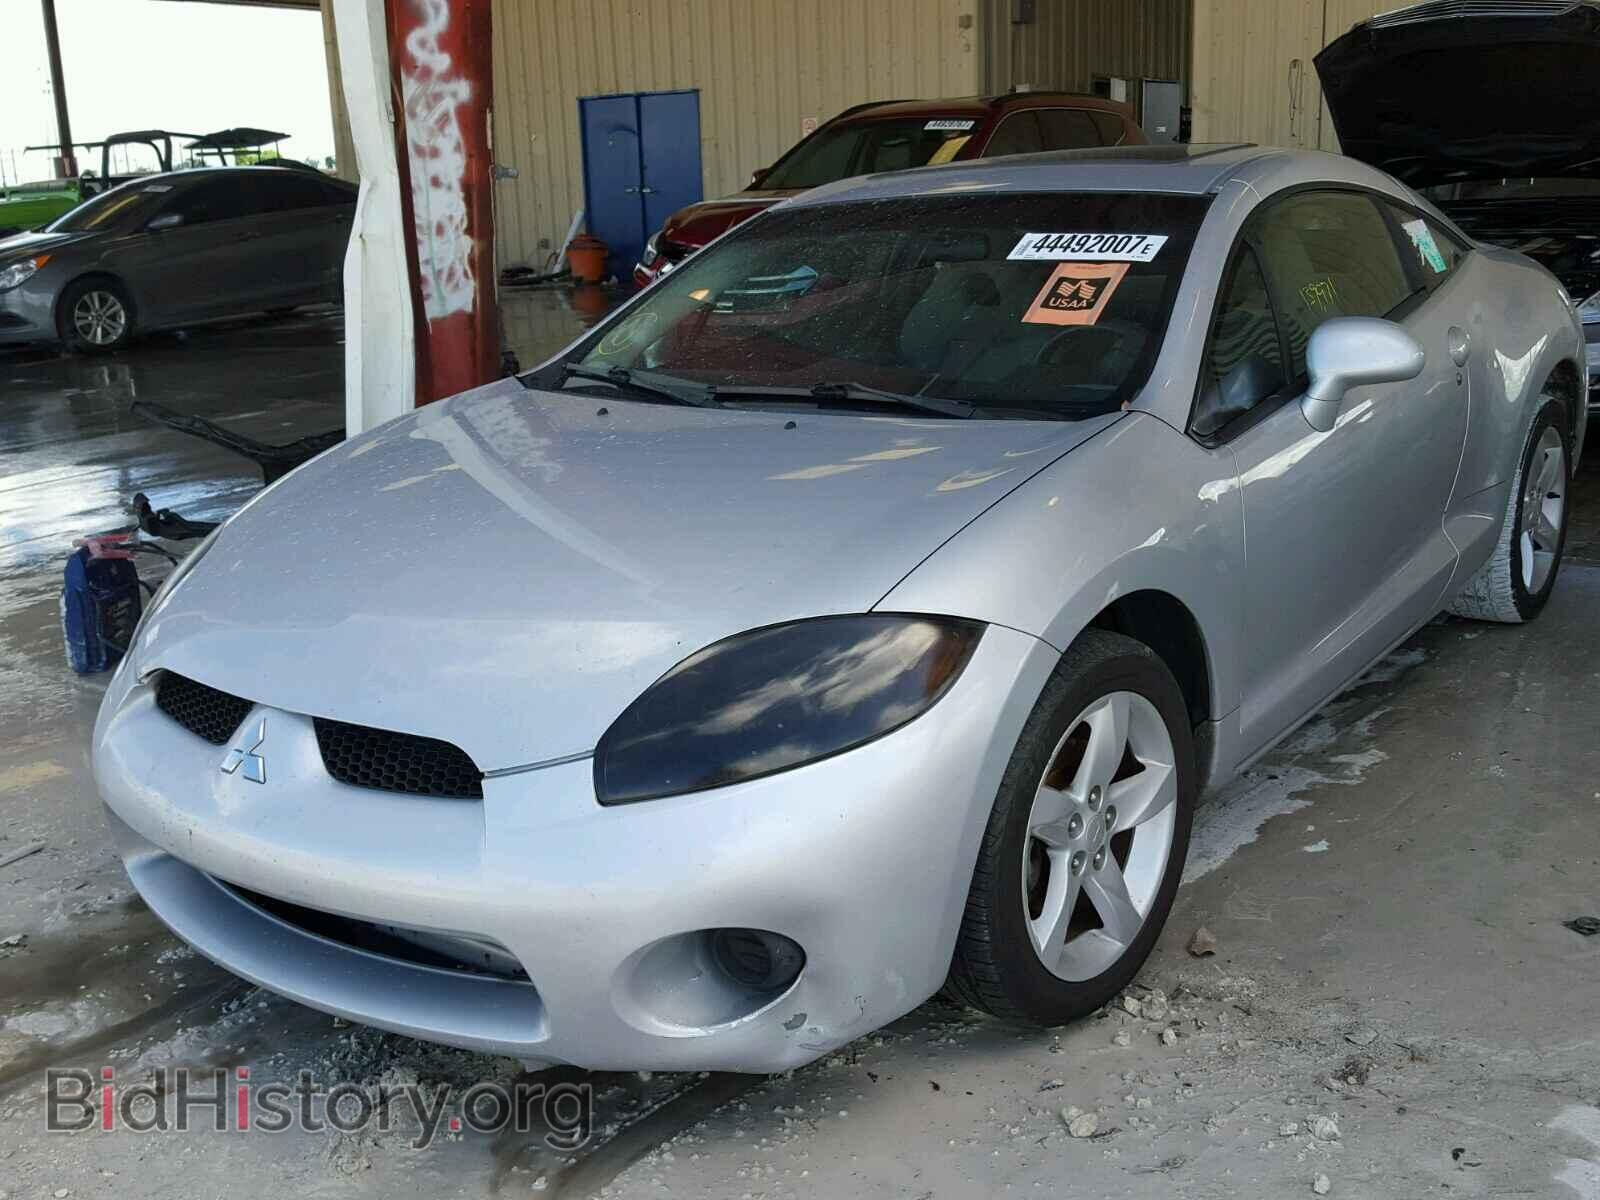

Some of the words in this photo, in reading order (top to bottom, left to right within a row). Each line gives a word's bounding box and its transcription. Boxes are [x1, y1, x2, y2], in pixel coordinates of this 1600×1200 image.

[1032, 234, 1148, 254] 44492007
[1142, 244, 1154, 255] E
[1049, 297, 1088, 308] USAA
